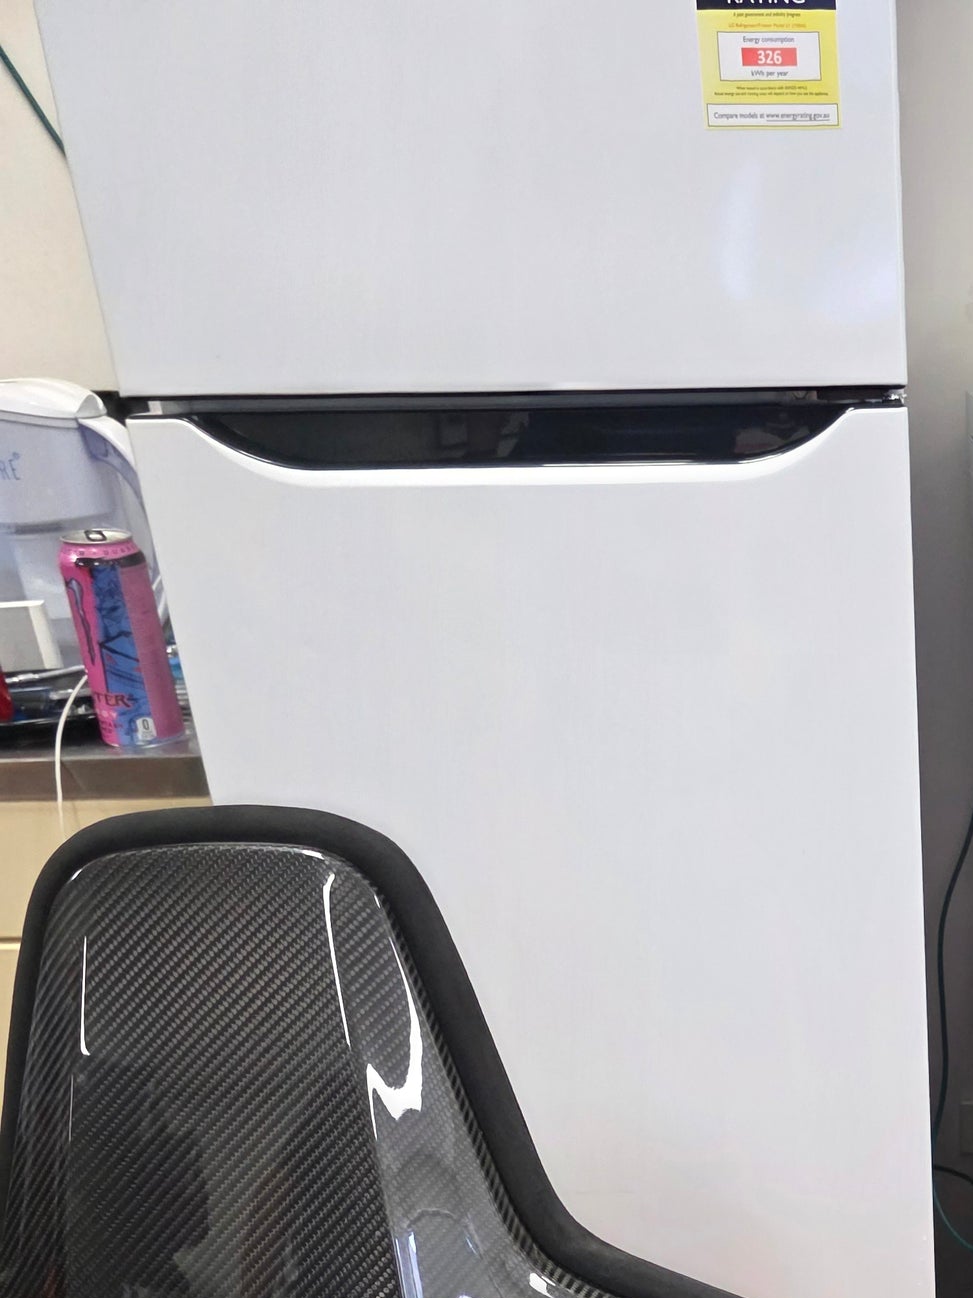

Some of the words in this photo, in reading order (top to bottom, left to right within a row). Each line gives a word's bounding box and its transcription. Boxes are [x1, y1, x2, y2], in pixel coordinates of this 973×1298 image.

[742, 36, 760, 44] Energy
[757, 50, 782, 64] 326
[713, 112, 738, 120] Compare
